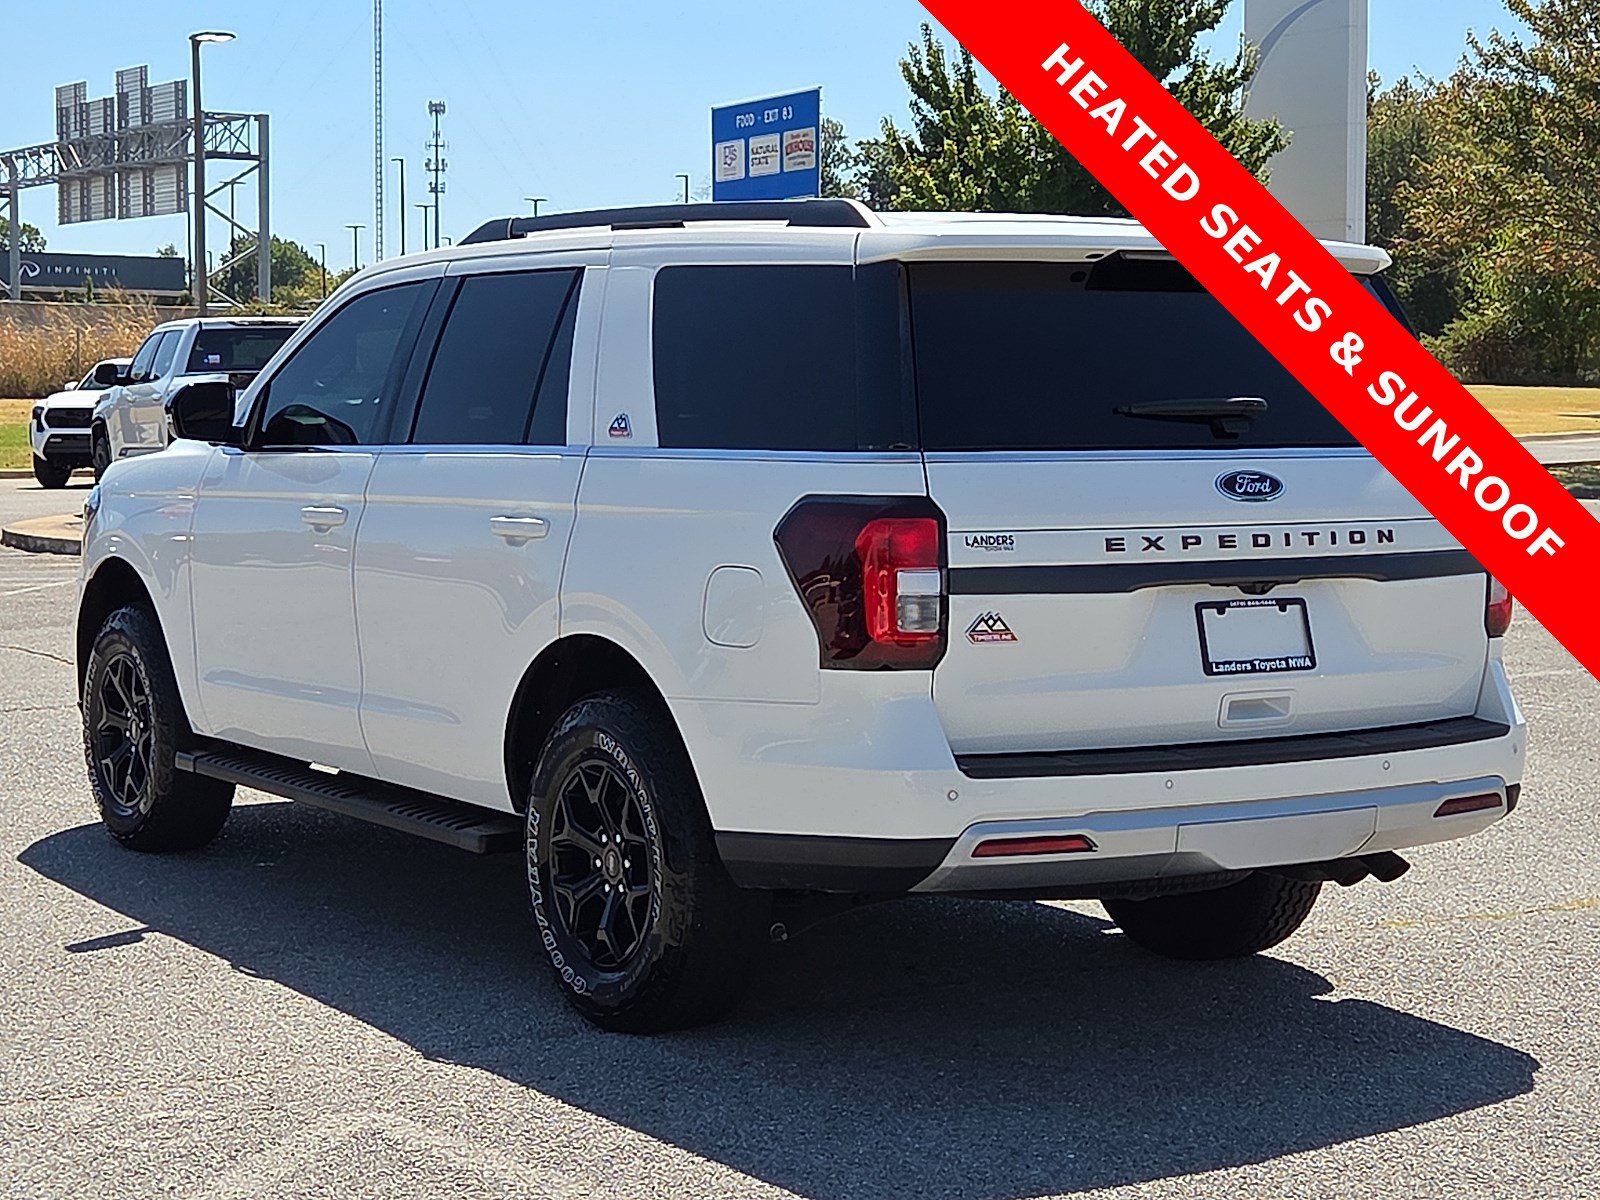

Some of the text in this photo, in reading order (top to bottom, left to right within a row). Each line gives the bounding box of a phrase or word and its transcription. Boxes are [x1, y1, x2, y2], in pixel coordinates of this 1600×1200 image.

[736, 113, 755, 128] FOOD
[764, 108, 779, 123] EXIT
[751, 143, 779, 156] NATURAL
[751, 156, 769, 167] STATE
[47, 265, 117, 276] INFINITI
[1235, 474, 1272, 494] Ford
[965, 535, 1015, 548] LANDERS
[1104, 529, 1396, 553] EXPEDITION
[1212, 657, 1313, 672] Landers Toyota NWA
[527, 807, 588, 994] GOODYEAR
